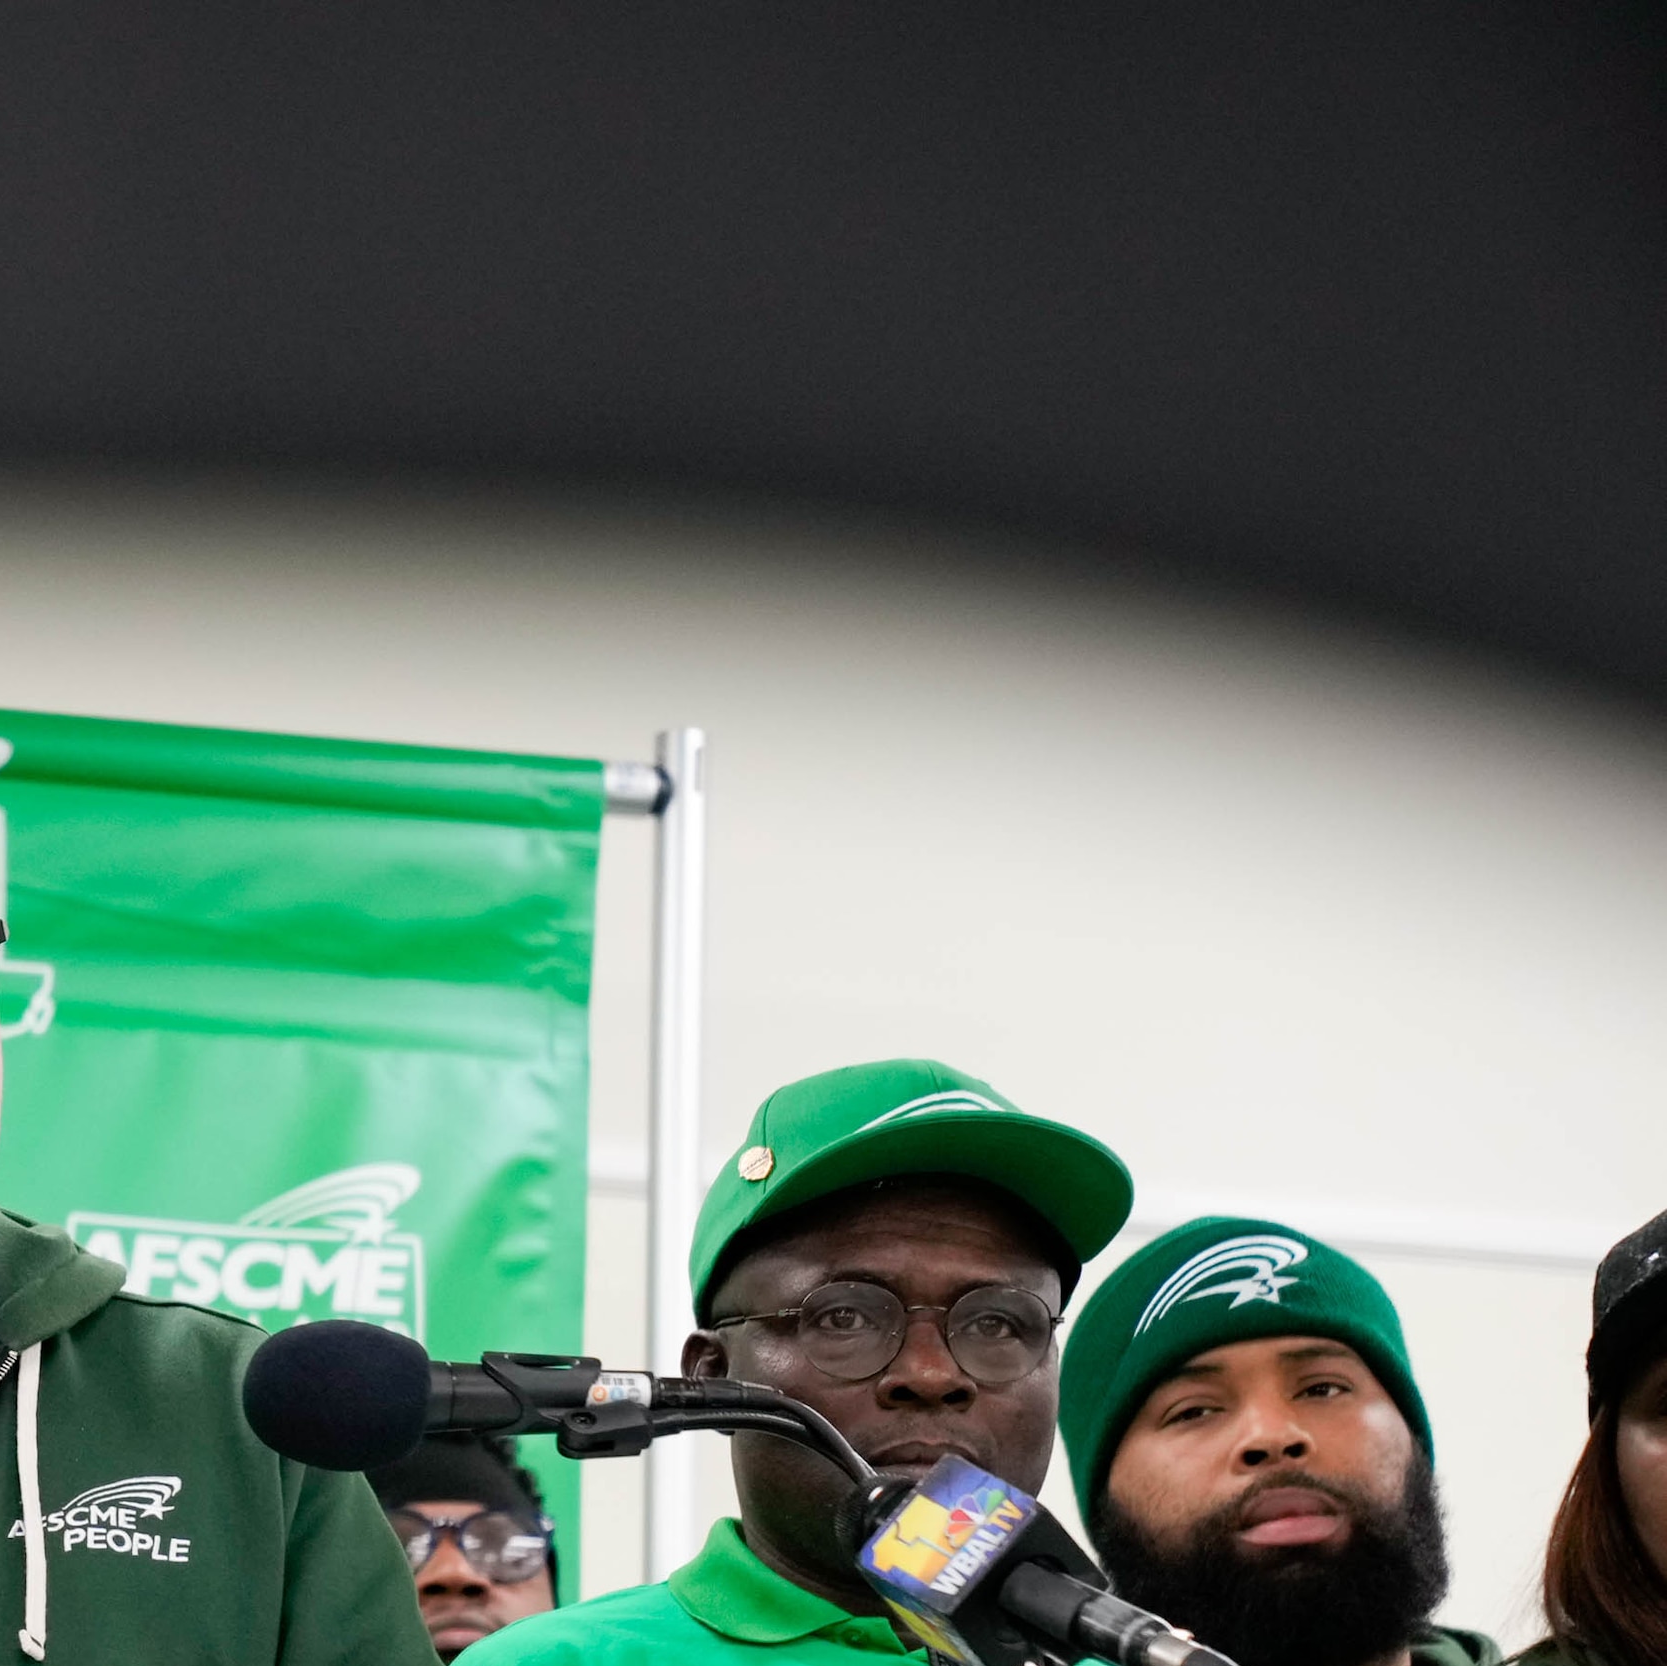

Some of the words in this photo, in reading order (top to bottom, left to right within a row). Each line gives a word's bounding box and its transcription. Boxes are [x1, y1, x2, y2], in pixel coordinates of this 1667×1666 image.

[1252, 1279, 1274, 1296] 3
[7, 1504, 137, 1539] ASCME
[63, 1527, 192, 1563] PEOPLE
